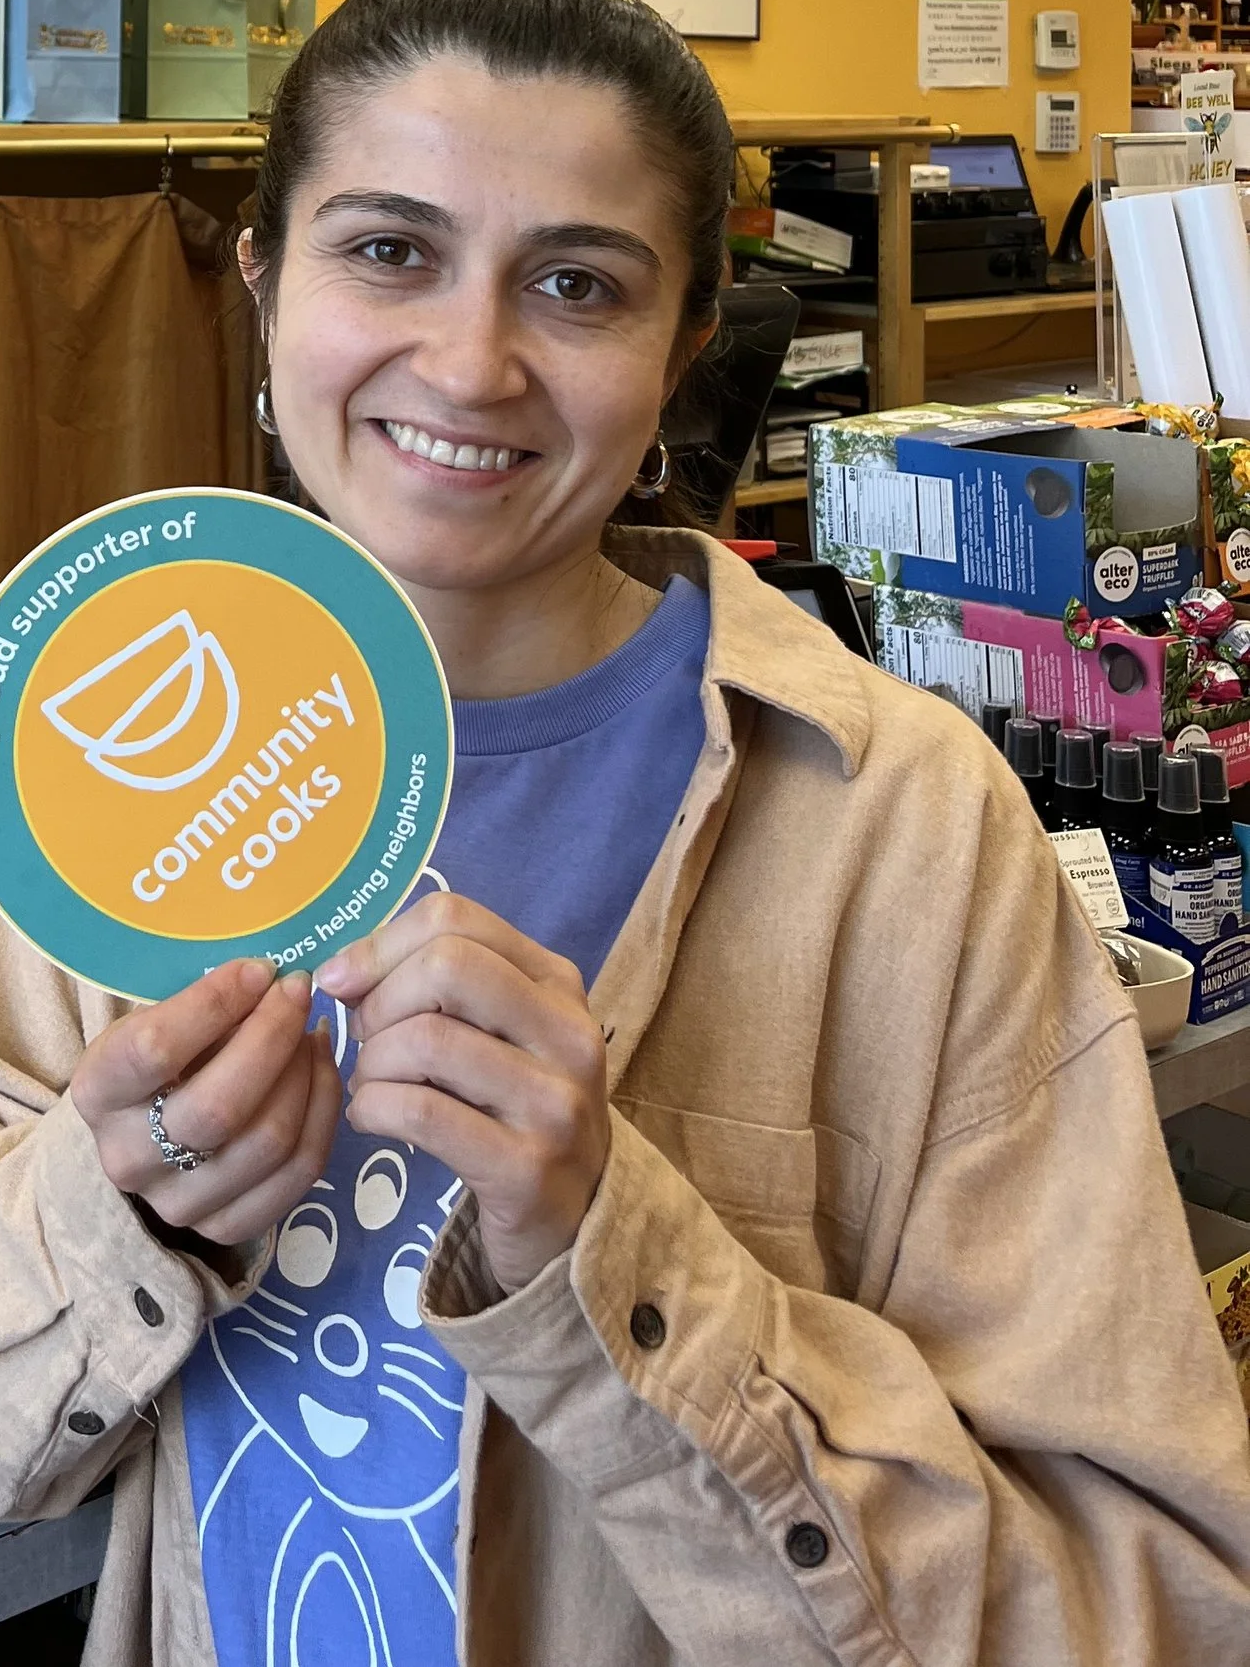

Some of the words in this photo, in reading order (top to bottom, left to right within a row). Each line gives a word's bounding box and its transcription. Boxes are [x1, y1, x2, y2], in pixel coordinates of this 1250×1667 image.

[1150, 56, 1192, 72] Sleep
[1186, 95, 1203, 110] BEE
[1206, 93, 1231, 108] WELL
[848, 467, 856, 482] 80
[826, 496, 834, 540] Nutrition
[1230, 544, 1250, 561] alte
[11, 520, 154, 637] supporter
[161, 511, 197, 541] of
[1100, 563, 1134, 579] alter
[1142, 558, 1180, 574] SUPERDARK
[1104, 577, 1130, 591] eco
[1142, 570, 1175, 585] TRUFFLES
[886, 626, 894, 656] Facts
[131, 672, 357, 905] community
[220, 762, 342, 891] cooks
[316, 868, 390, 943] helping
[380, 751, 428, 870] neighbors
[1060, 856, 1092, 868] Sprouted
[1093, 854, 1107, 864] Nut
[1070, 867, 1110, 881] Espresso
[1087, 880, 1115, 890] Brownie
[1214, 899, 1234, 908] HAND
[1129, 916, 1145, 929] ne!
[1175, 910, 1198, 921] HAND
[1201, 973, 1223, 996] HAND
